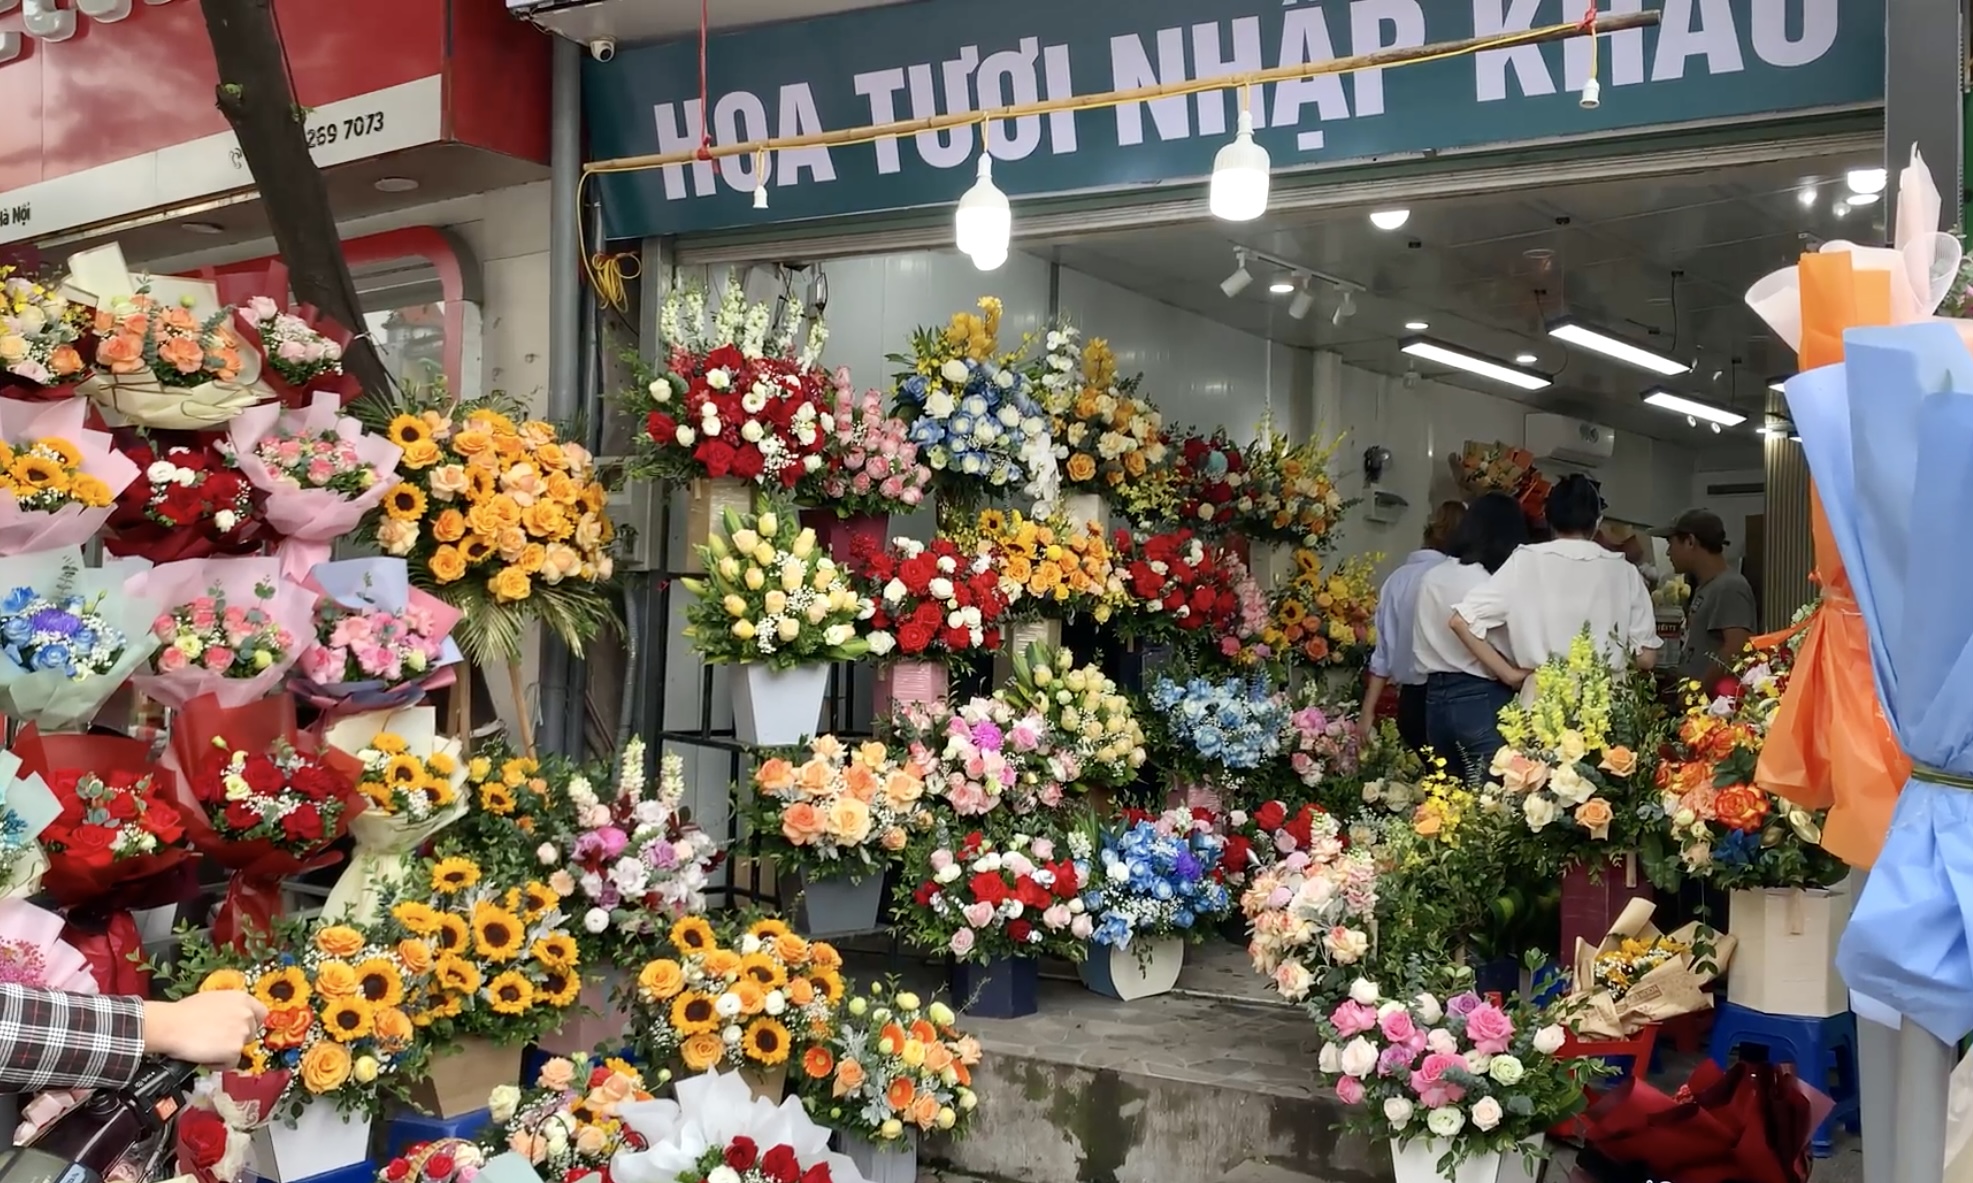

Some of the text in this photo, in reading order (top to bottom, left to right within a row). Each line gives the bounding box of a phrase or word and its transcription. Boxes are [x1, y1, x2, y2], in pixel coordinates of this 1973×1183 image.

[653, 82, 837, 200] HOA
[853, 36, 1078, 175] TƯƠI
[1109, 0, 1426, 151] NHẬP
[343, 111, 385, 139] 7073
[12, 201, 31, 226] Nội
